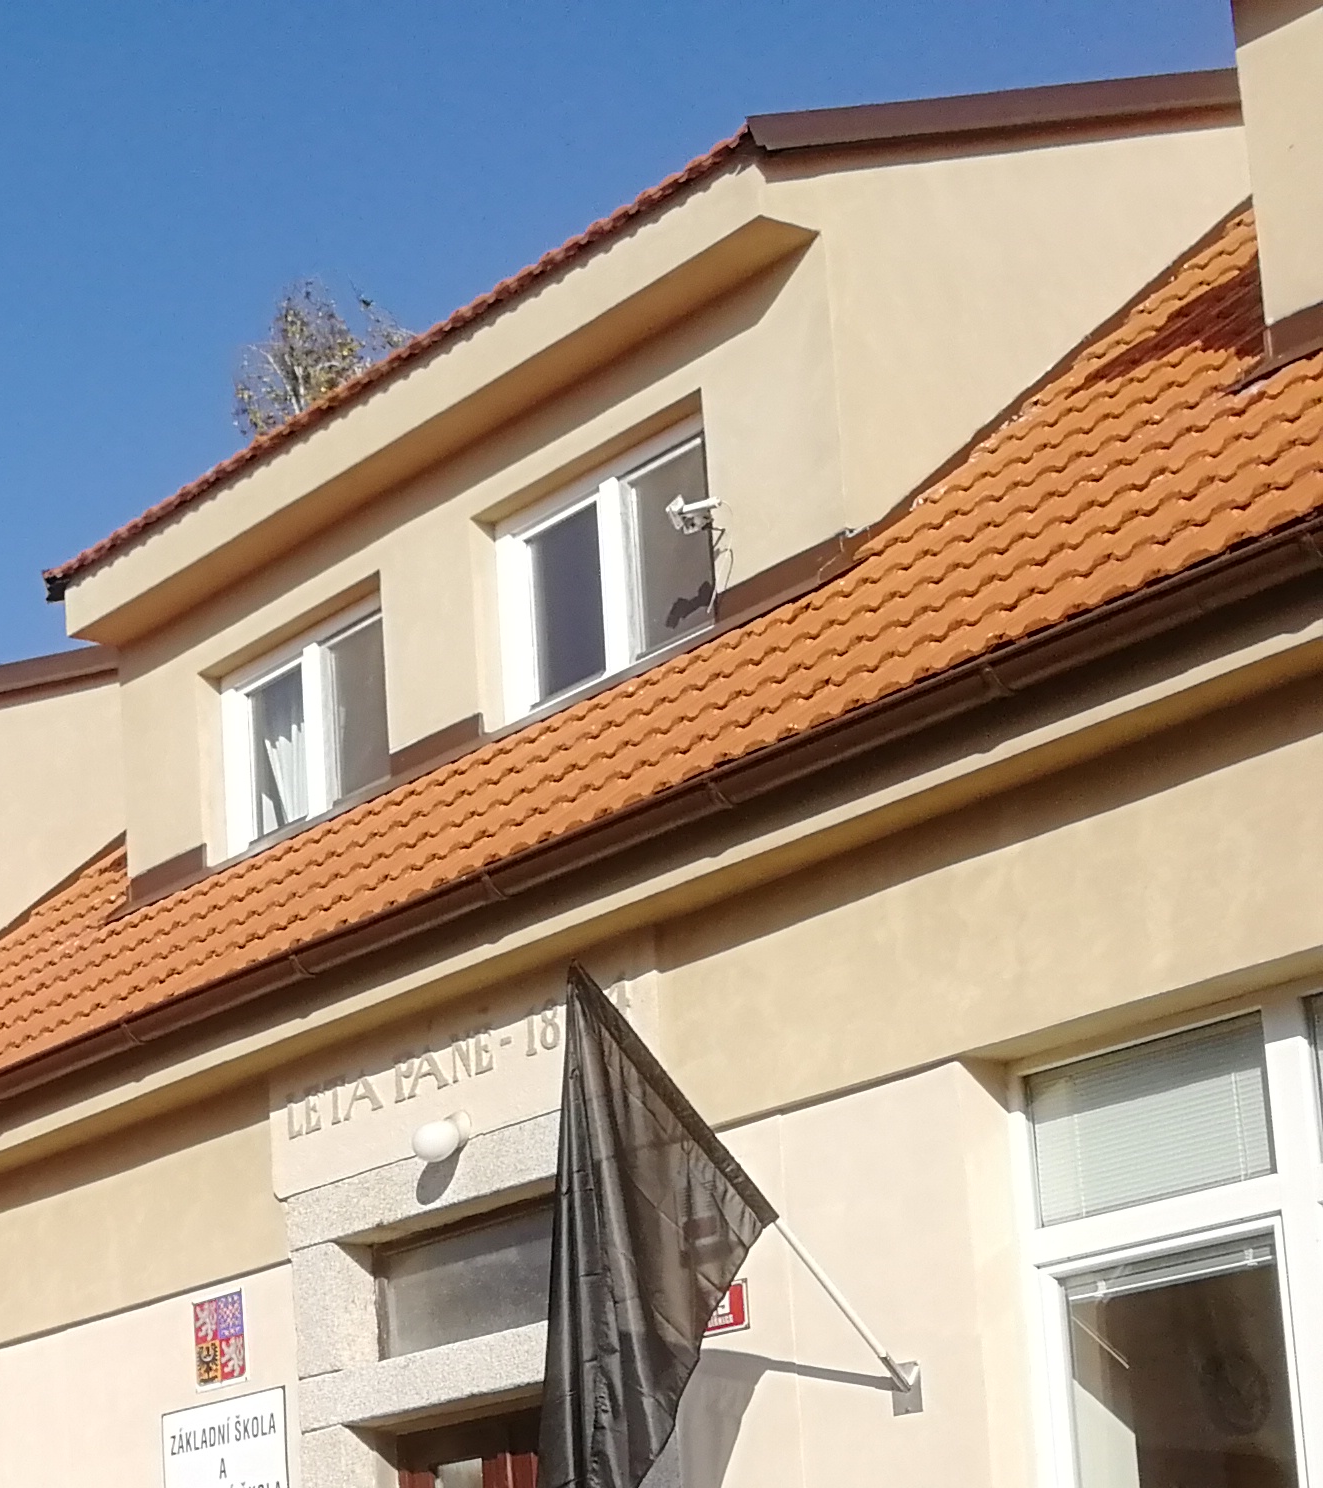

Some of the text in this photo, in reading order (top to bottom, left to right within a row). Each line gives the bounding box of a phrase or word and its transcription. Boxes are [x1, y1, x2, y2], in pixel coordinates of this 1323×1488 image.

[286, 1069, 384, 1140] LETA
[170, 1413, 276, 1456] ZÁKLADNÍ ŠKOLA
[218, 1457, 228, 1480] A
